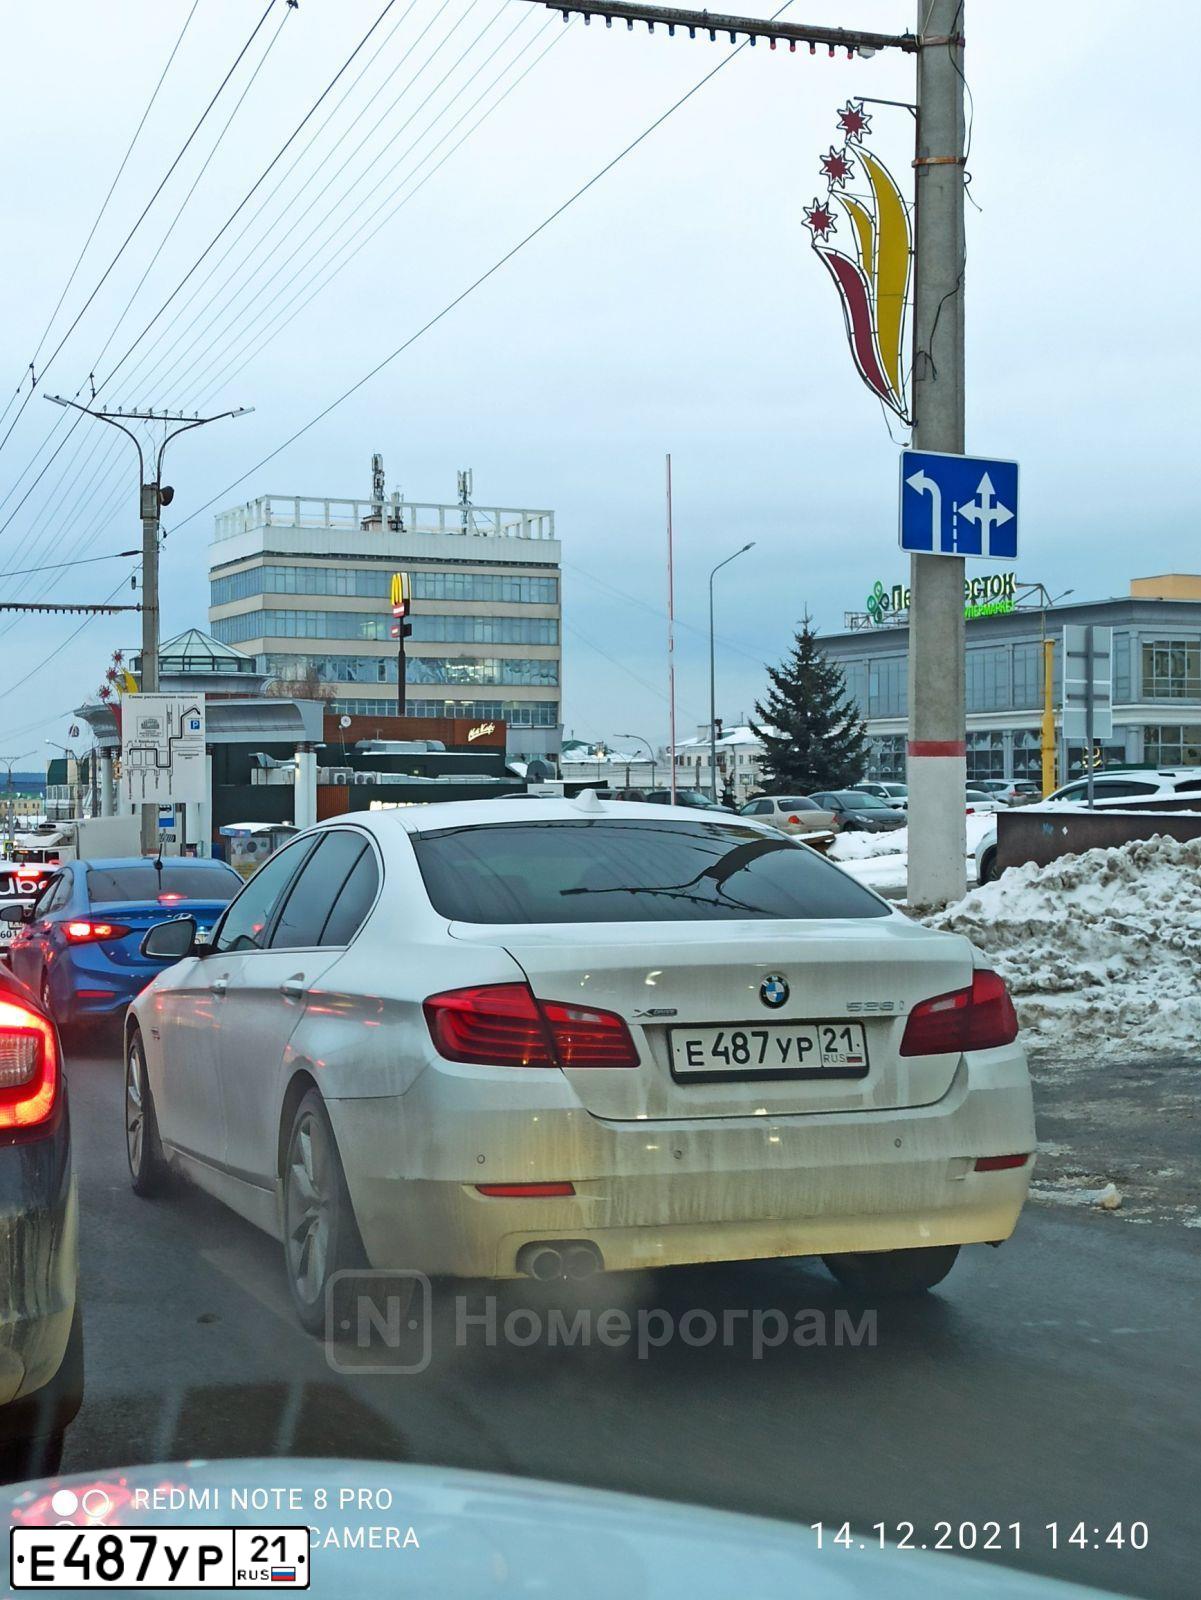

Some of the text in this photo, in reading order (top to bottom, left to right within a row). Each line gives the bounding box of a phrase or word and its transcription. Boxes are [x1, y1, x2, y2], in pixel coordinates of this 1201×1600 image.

[892, 572, 1015, 610] Пеесток
[823, 1027, 853, 1052] 21
[823, 1055, 847, 1063] RUS
